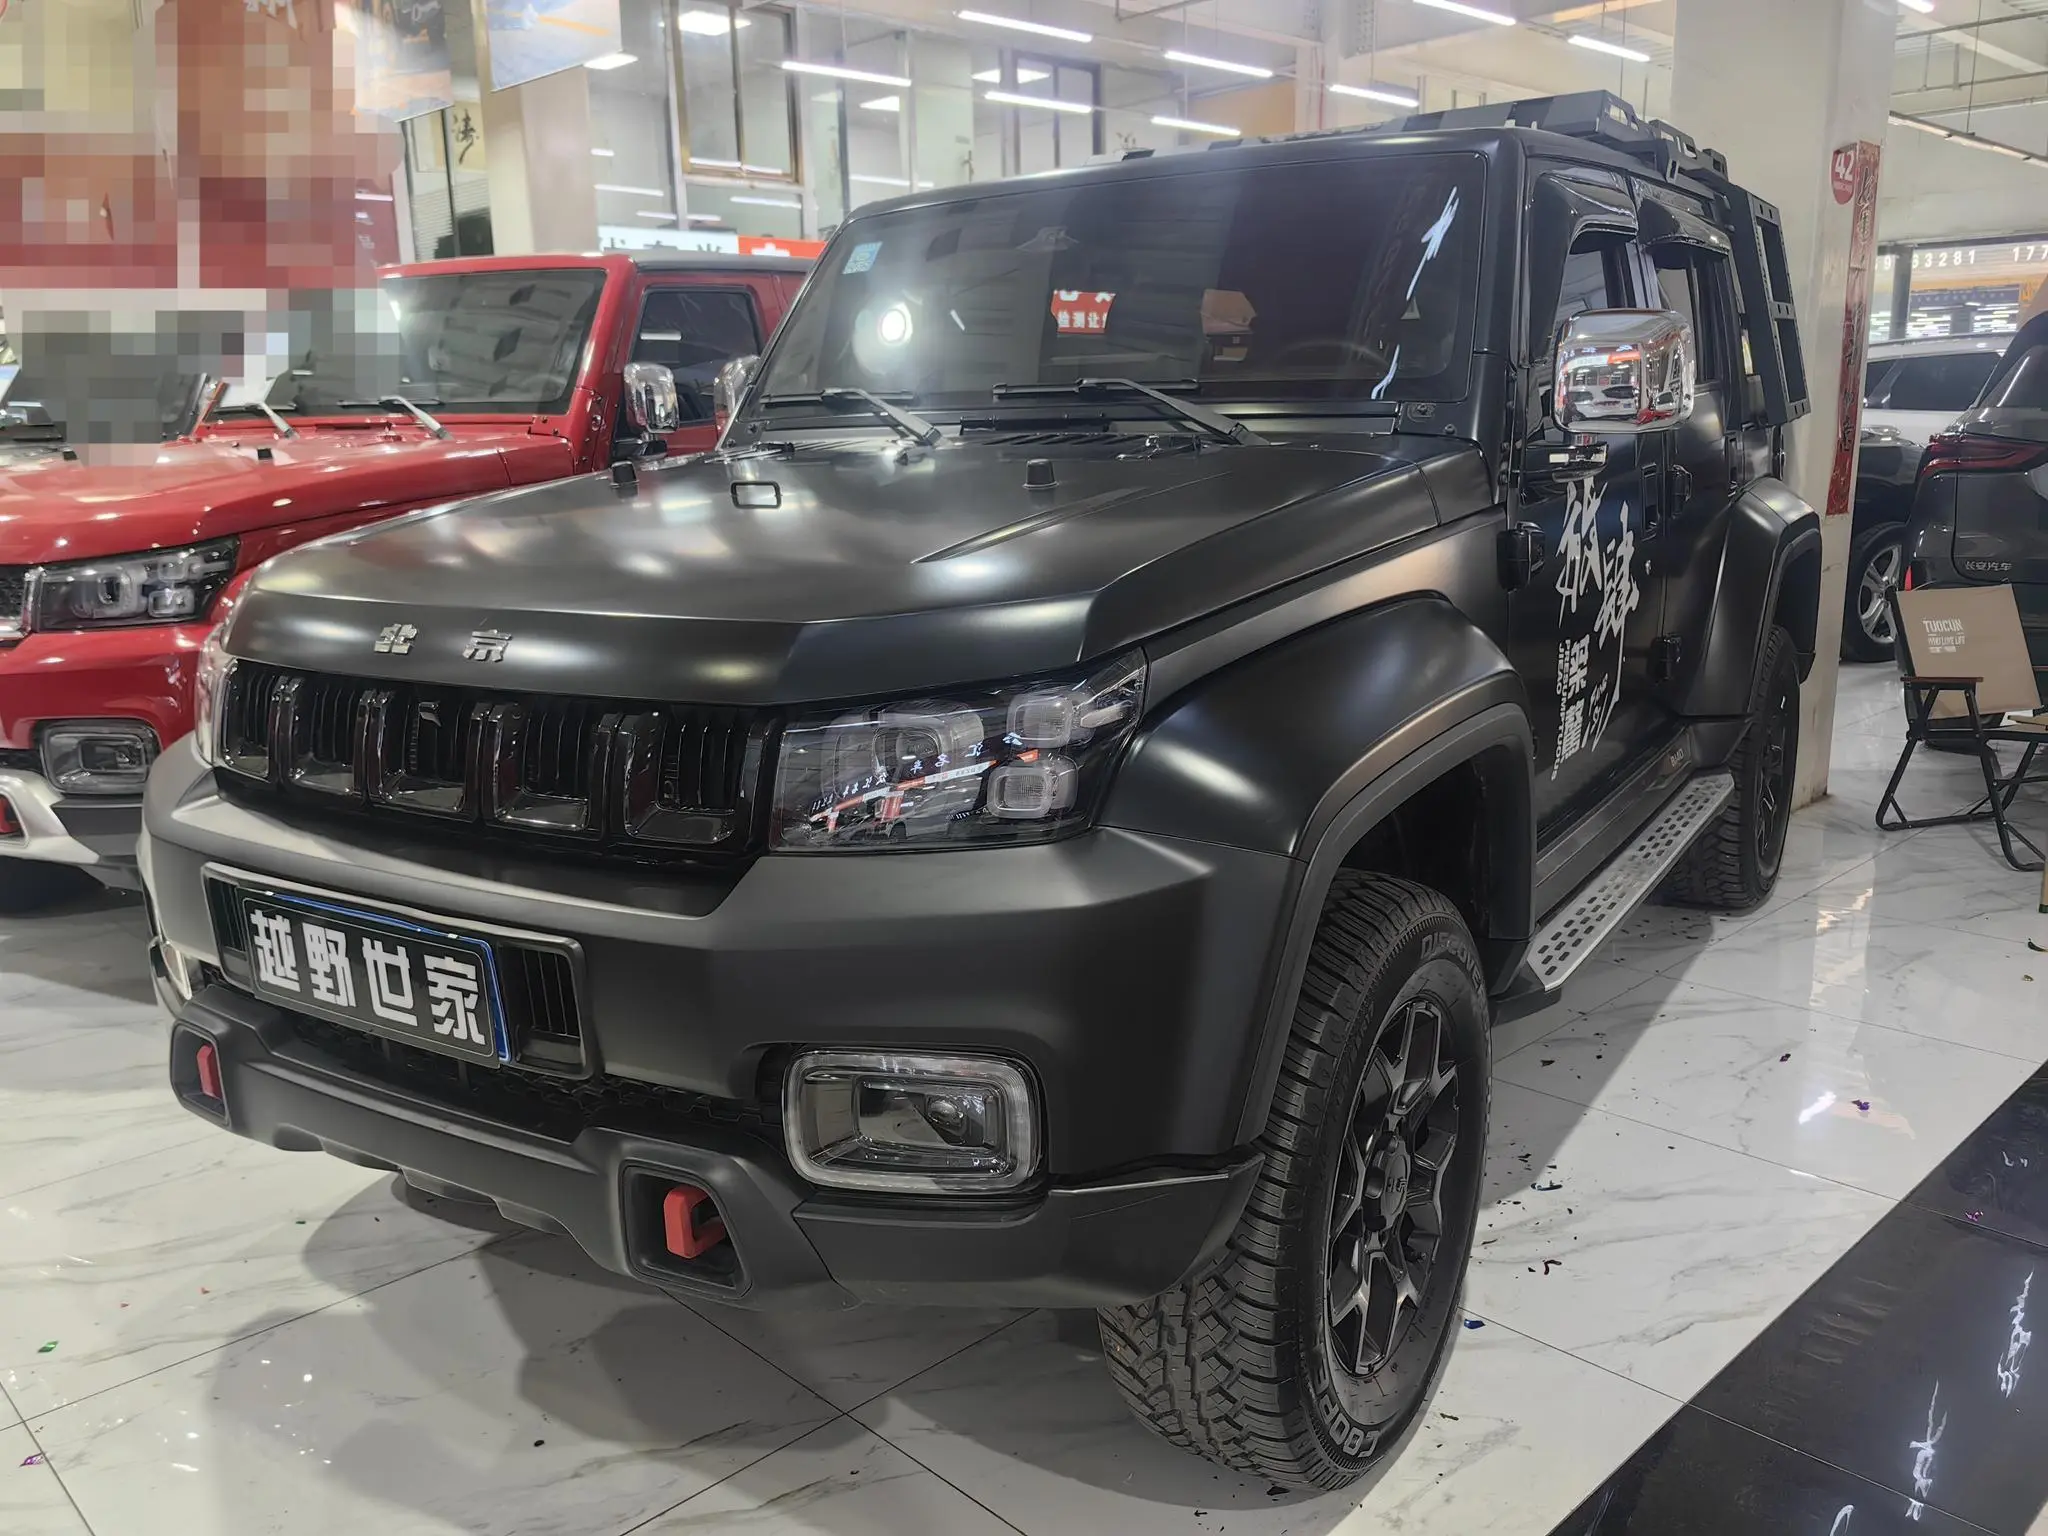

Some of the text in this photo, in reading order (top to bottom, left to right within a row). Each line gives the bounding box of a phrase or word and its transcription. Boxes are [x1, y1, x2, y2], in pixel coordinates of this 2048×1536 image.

[1834, 150, 1855, 182] 42
[373, 623, 513, 663] 北京
[250, 909, 487, 1046] 越野世家
